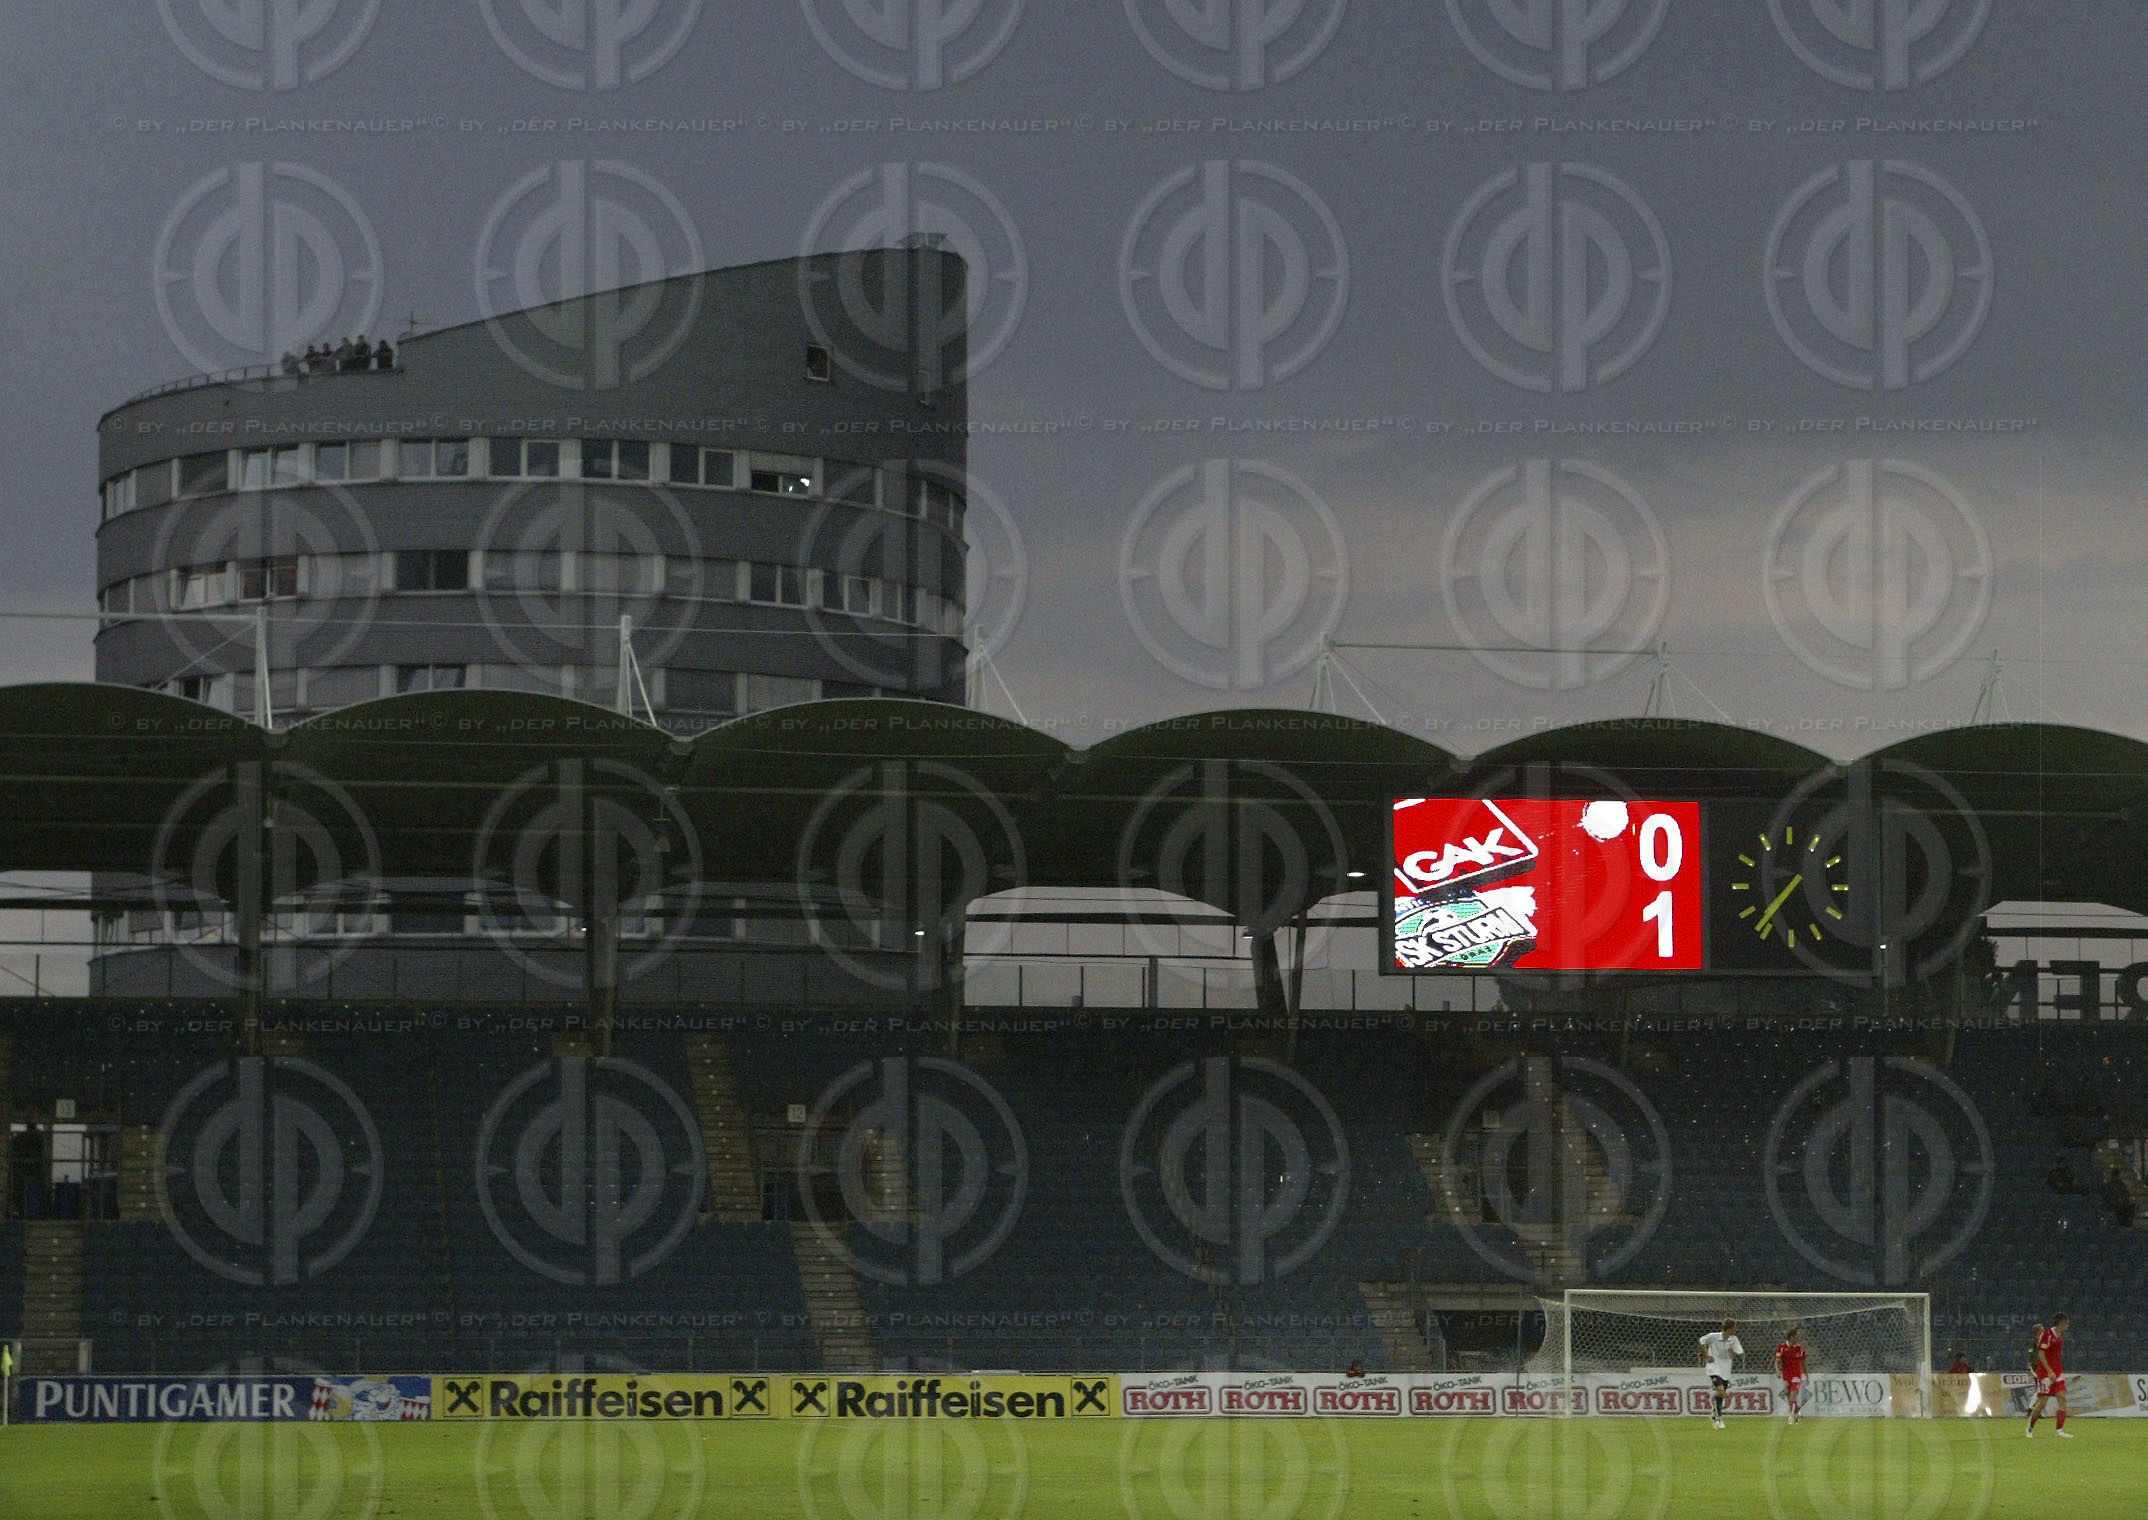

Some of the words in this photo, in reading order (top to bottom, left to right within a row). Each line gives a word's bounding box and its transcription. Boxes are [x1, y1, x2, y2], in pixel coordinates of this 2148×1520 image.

[1403, 827, 1523, 882] GAK
[1639, 813, 1683, 881] 0
[1395, 936, 1444, 966] SK
[1432, 909, 1525, 953] STURM
[1642, 890, 1674, 957] 1
[35, 1380, 295, 1418] PUNTIGAMER
[490, 1378, 723, 1417] Raiffeisen
[837, 1379, 1064, 1417] Raiffeisen
[1129, 1391, 1207, 1410] ROTH
[1225, 1391, 1302, 1410] ROTH
[1319, 1391, 1396, 1410] ROTH
[1413, 1391, 1491, 1410] ROTH
[1602, 1391, 1678, 1410] ROTH
[1814, 1379, 1884, 1405] BEWO
